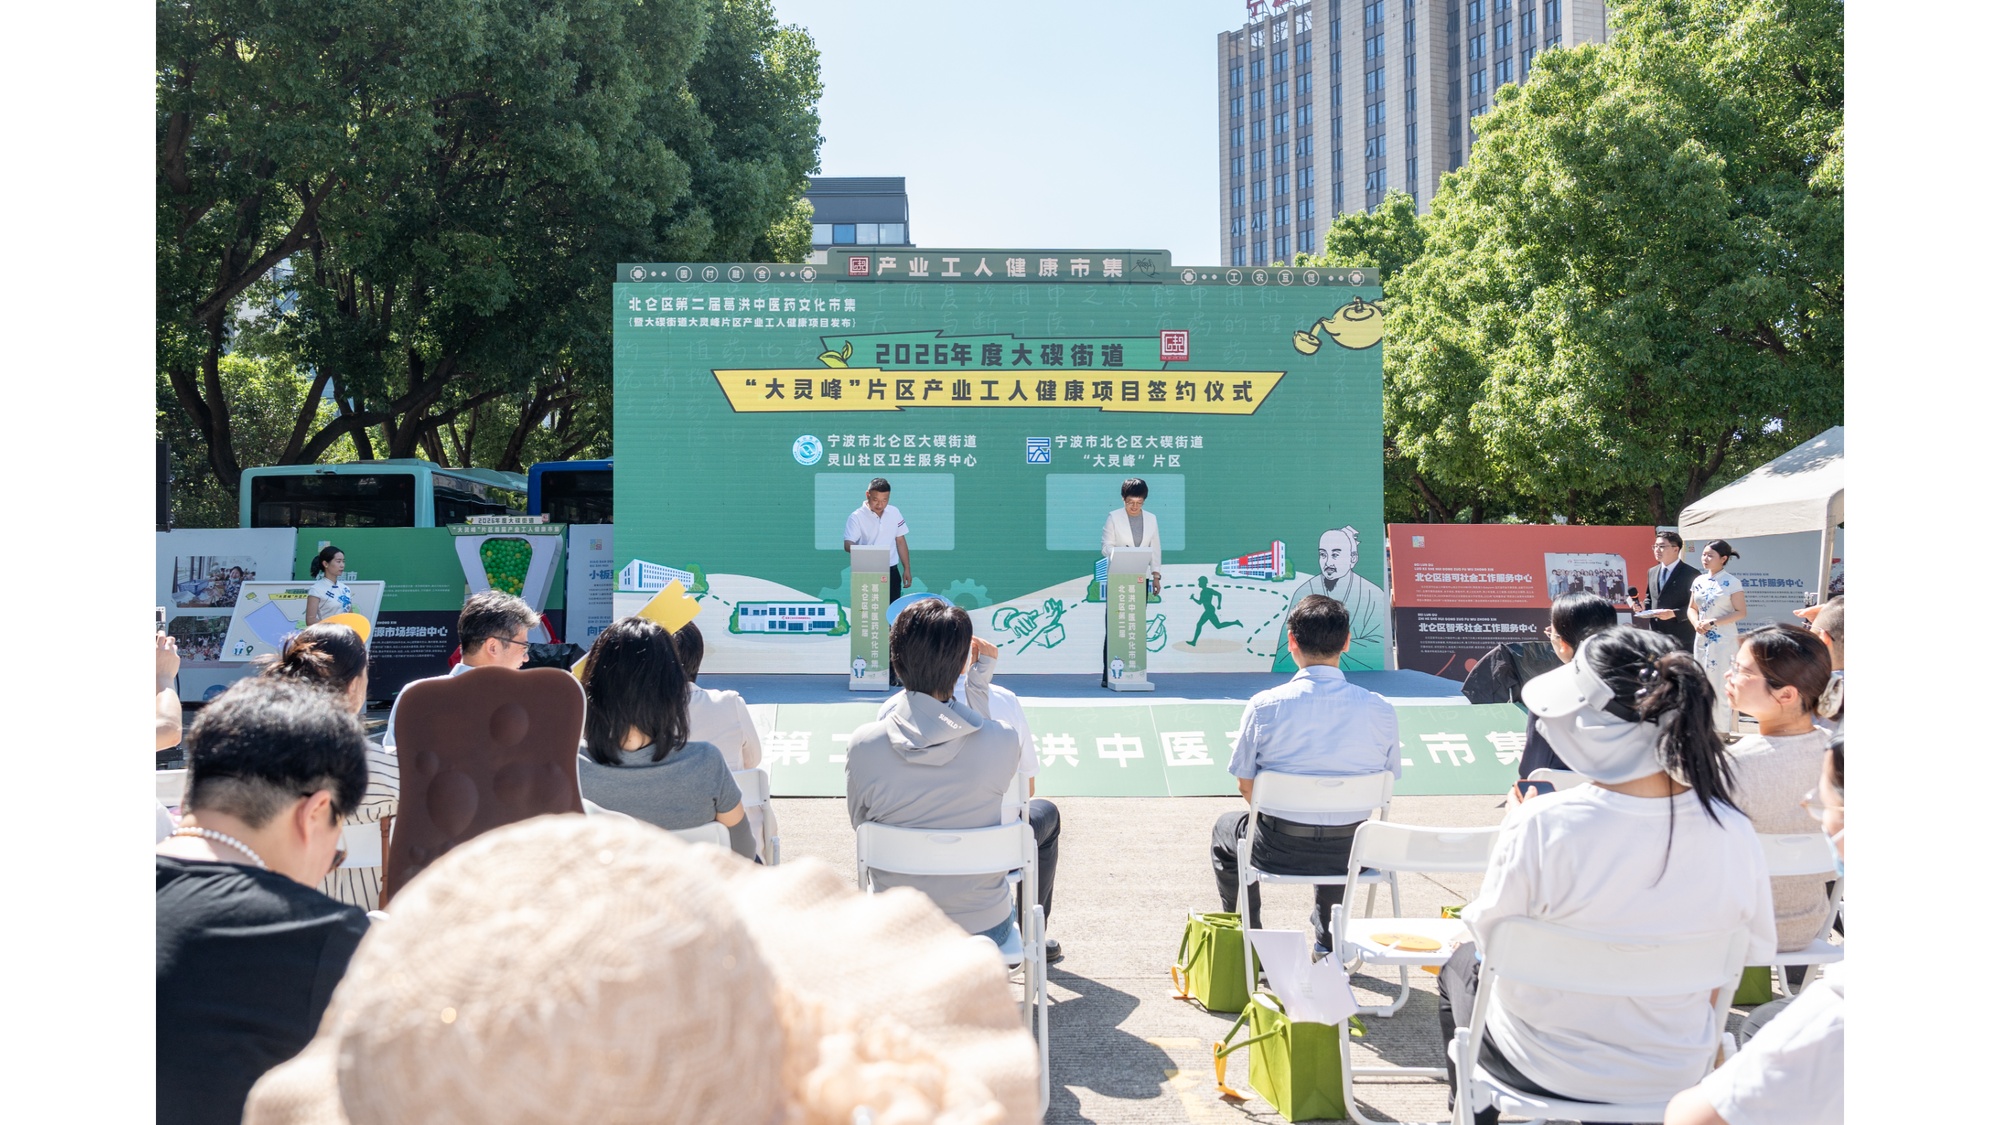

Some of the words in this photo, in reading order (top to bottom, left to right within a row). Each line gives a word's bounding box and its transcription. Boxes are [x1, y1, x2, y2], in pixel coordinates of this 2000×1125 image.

[876, 256, 1123, 278] 产业工人健康市集
[628, 297, 856, 312] 北仑区第二届葛洪中医药文化市集
[876, 343, 1124, 367] 2026年度大碶街道
[745, 378, 1253, 402] “大灵峰”片区产业工人健康项目签约仪式
[827, 434, 977, 448] 宁波市北仑区大碶街道
[1055, 435, 1204, 449] 宁波市北仑区大碶街道
[827, 453, 977, 467] 灵山社区卫生服务中心
[1415, 573, 1532, 583] 北仑区洛可社会工作服务中心
[1419, 623, 1537, 633] 北仑区智禾社会工作服务中心
